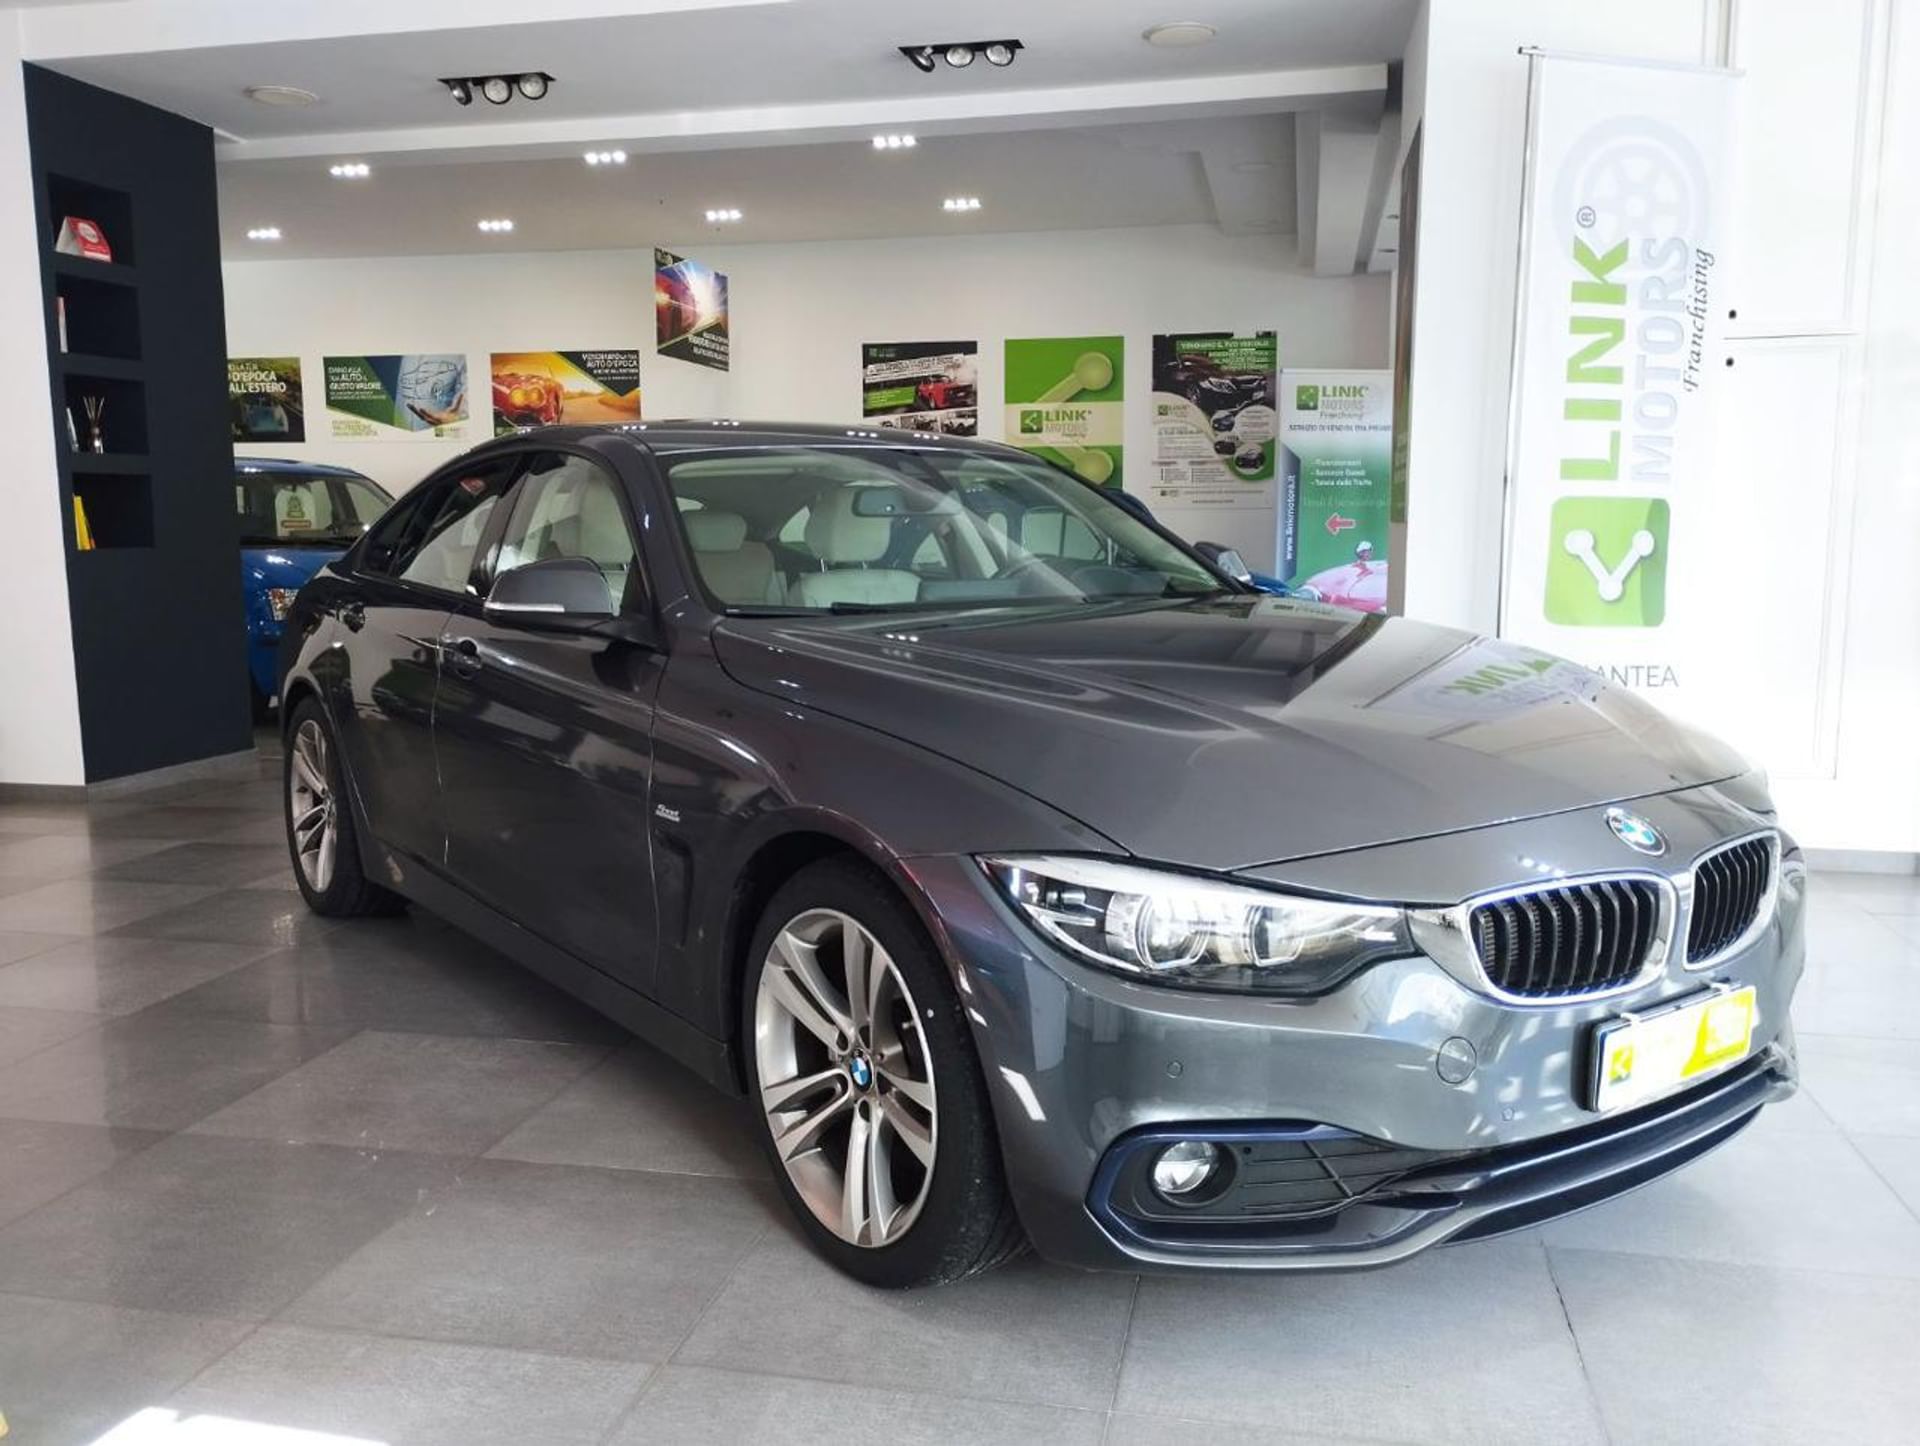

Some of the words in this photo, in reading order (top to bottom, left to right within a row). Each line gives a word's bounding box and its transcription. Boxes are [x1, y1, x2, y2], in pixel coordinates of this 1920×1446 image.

[1684, 247, 1716, 393] Franchising
[1630, 236, 1689, 482] MOTORS
[232, 371, 277, 382] D'EPOCA
[229, 382, 287, 393] ALL'ESTERO
[1321, 399, 1364, 410] MOTORS
